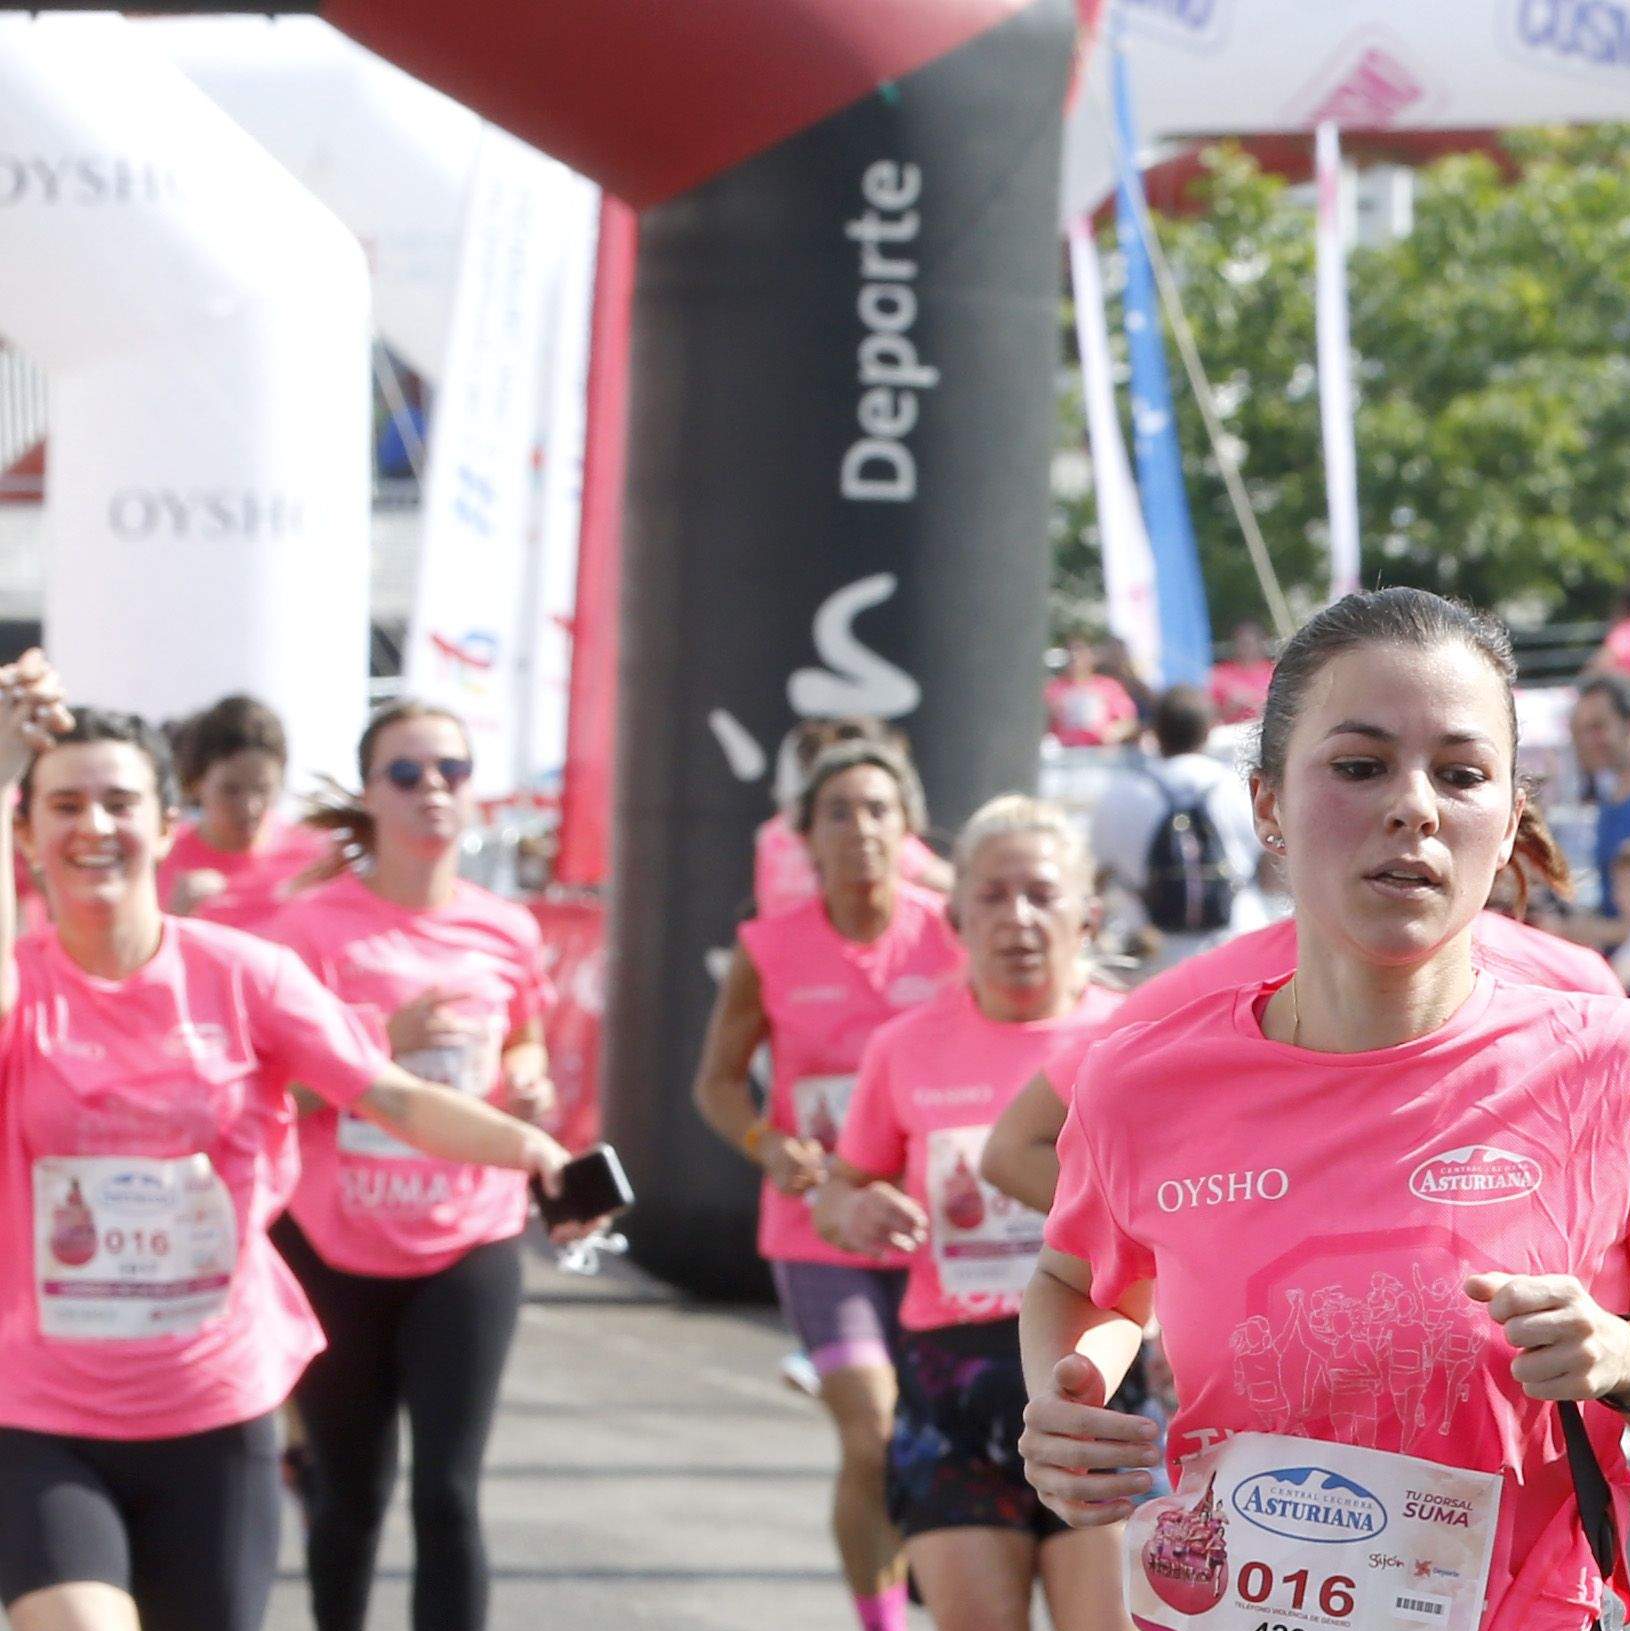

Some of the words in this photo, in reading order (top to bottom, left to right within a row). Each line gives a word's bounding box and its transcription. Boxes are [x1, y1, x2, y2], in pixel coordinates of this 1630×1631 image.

[840, 157, 941, 502] Deporte
[1157, 1168, 1290, 1213] OYSHO
[1419, 1169, 1533, 1193] ASTURIANA
[1243, 1486, 1374, 1532] ASTURIANA
[1270, 1487, 1319, 1500] CENTRAL
[1405, 1490, 1422, 1501] TU
[1423, 1493, 1474, 1511] DORSAL
[1402, 1502, 1469, 1528] SUMA
[1237, 1561, 1356, 1618] 016
